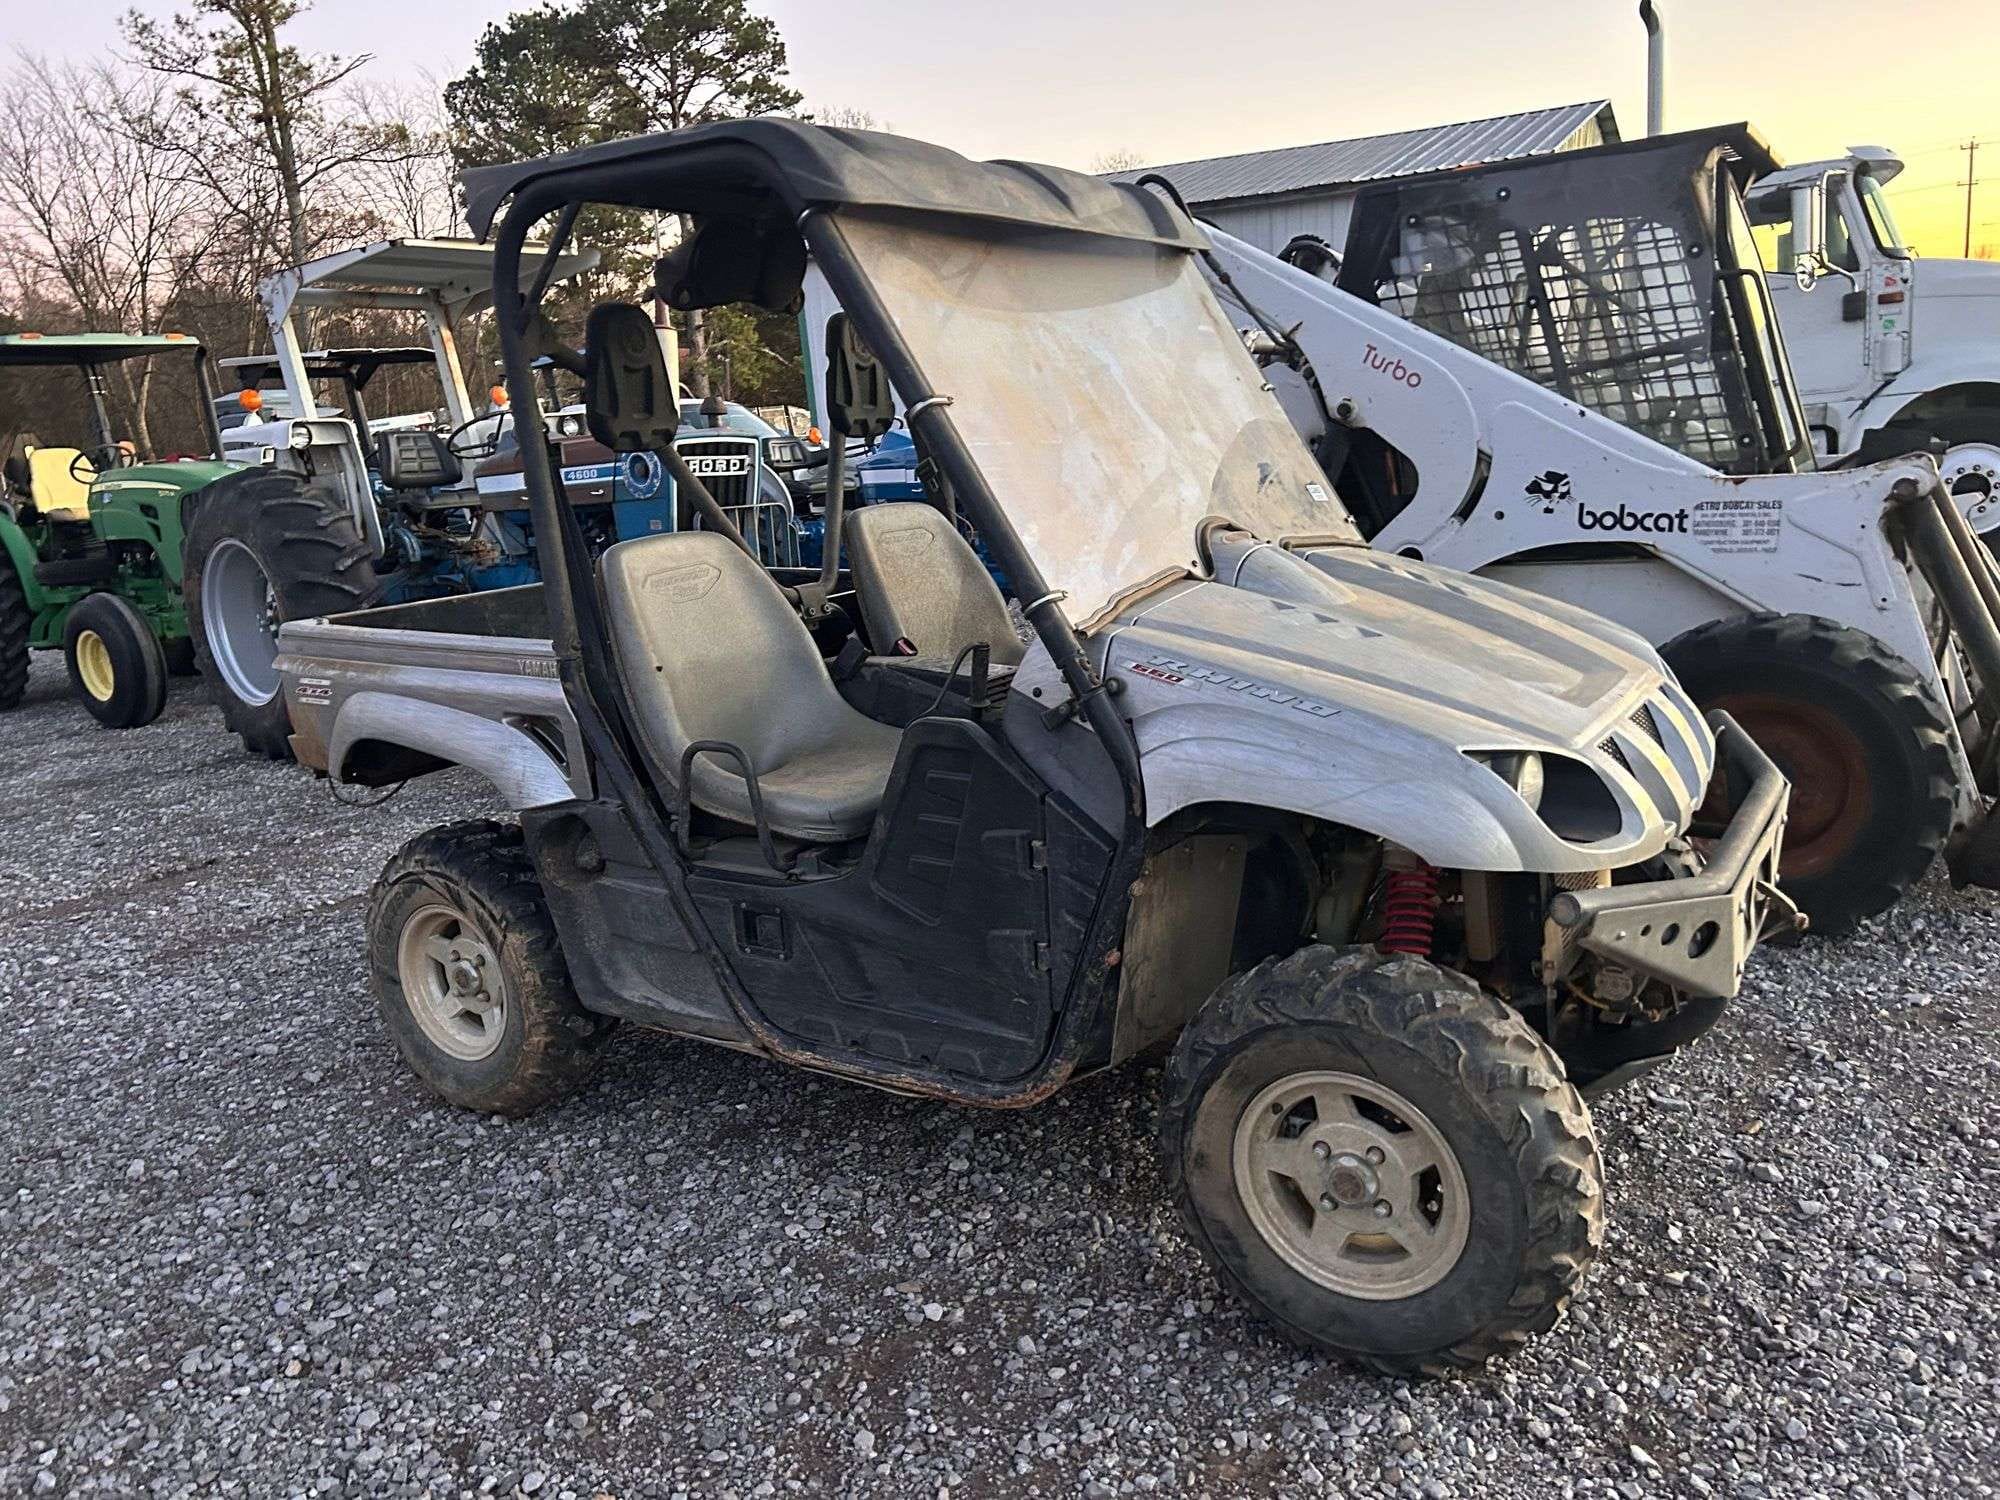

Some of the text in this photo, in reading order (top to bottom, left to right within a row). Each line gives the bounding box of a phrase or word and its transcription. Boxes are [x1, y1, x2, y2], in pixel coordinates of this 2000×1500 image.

[1363, 343, 1422, 388] Turbo
[567, 469, 598, 480] 4600
[689, 459, 740, 474] FORD
[1722, 500, 1755, 510] BOBCAT
[1757, 500, 1783, 510] SALES
[1578, 502, 1689, 533] bobcat
[517, 659, 558, 678] YAMAH
[1146, 654, 1342, 718] RHINO
